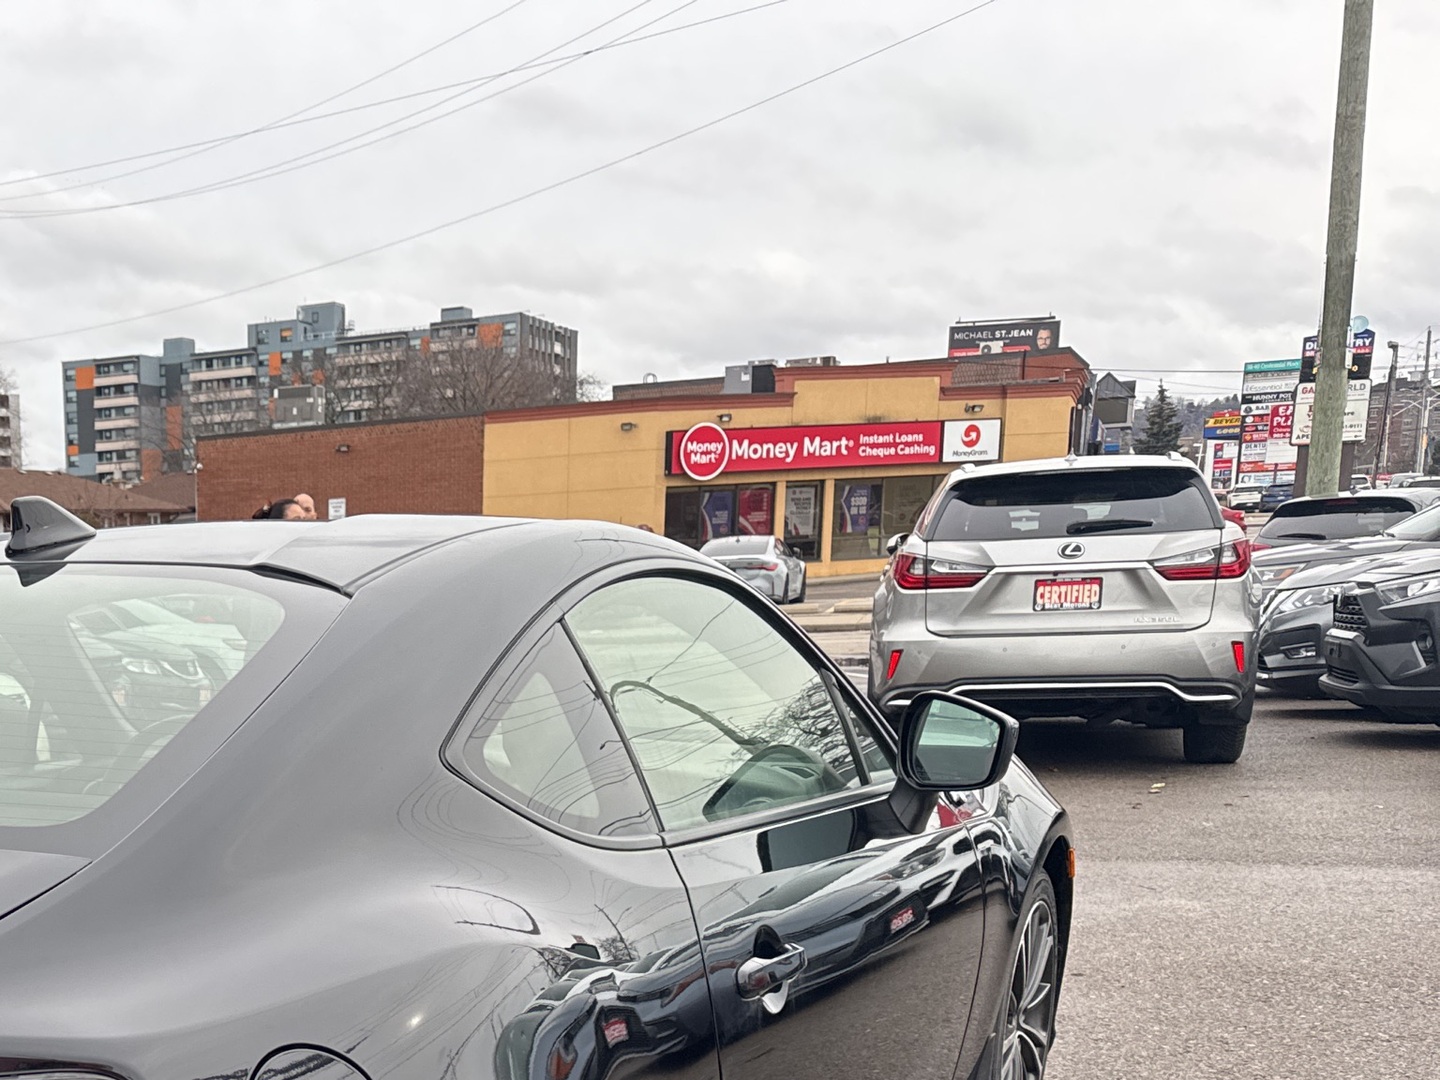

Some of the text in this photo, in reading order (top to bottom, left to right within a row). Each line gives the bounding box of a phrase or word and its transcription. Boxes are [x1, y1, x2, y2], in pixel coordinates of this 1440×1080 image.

[954, 331, 993, 340] MICHAEL
[860, 432, 924, 444] Instant Loans
[686, 441, 723, 454] Money
[731, 436, 848, 463] Money Mart
[859, 443, 936, 457] Cheque Cashing
[952, 449, 988, 458] MoneyGram
[690, 452, 717, 464] Mart
[1036, 584, 1100, 604] CERTIFIED
